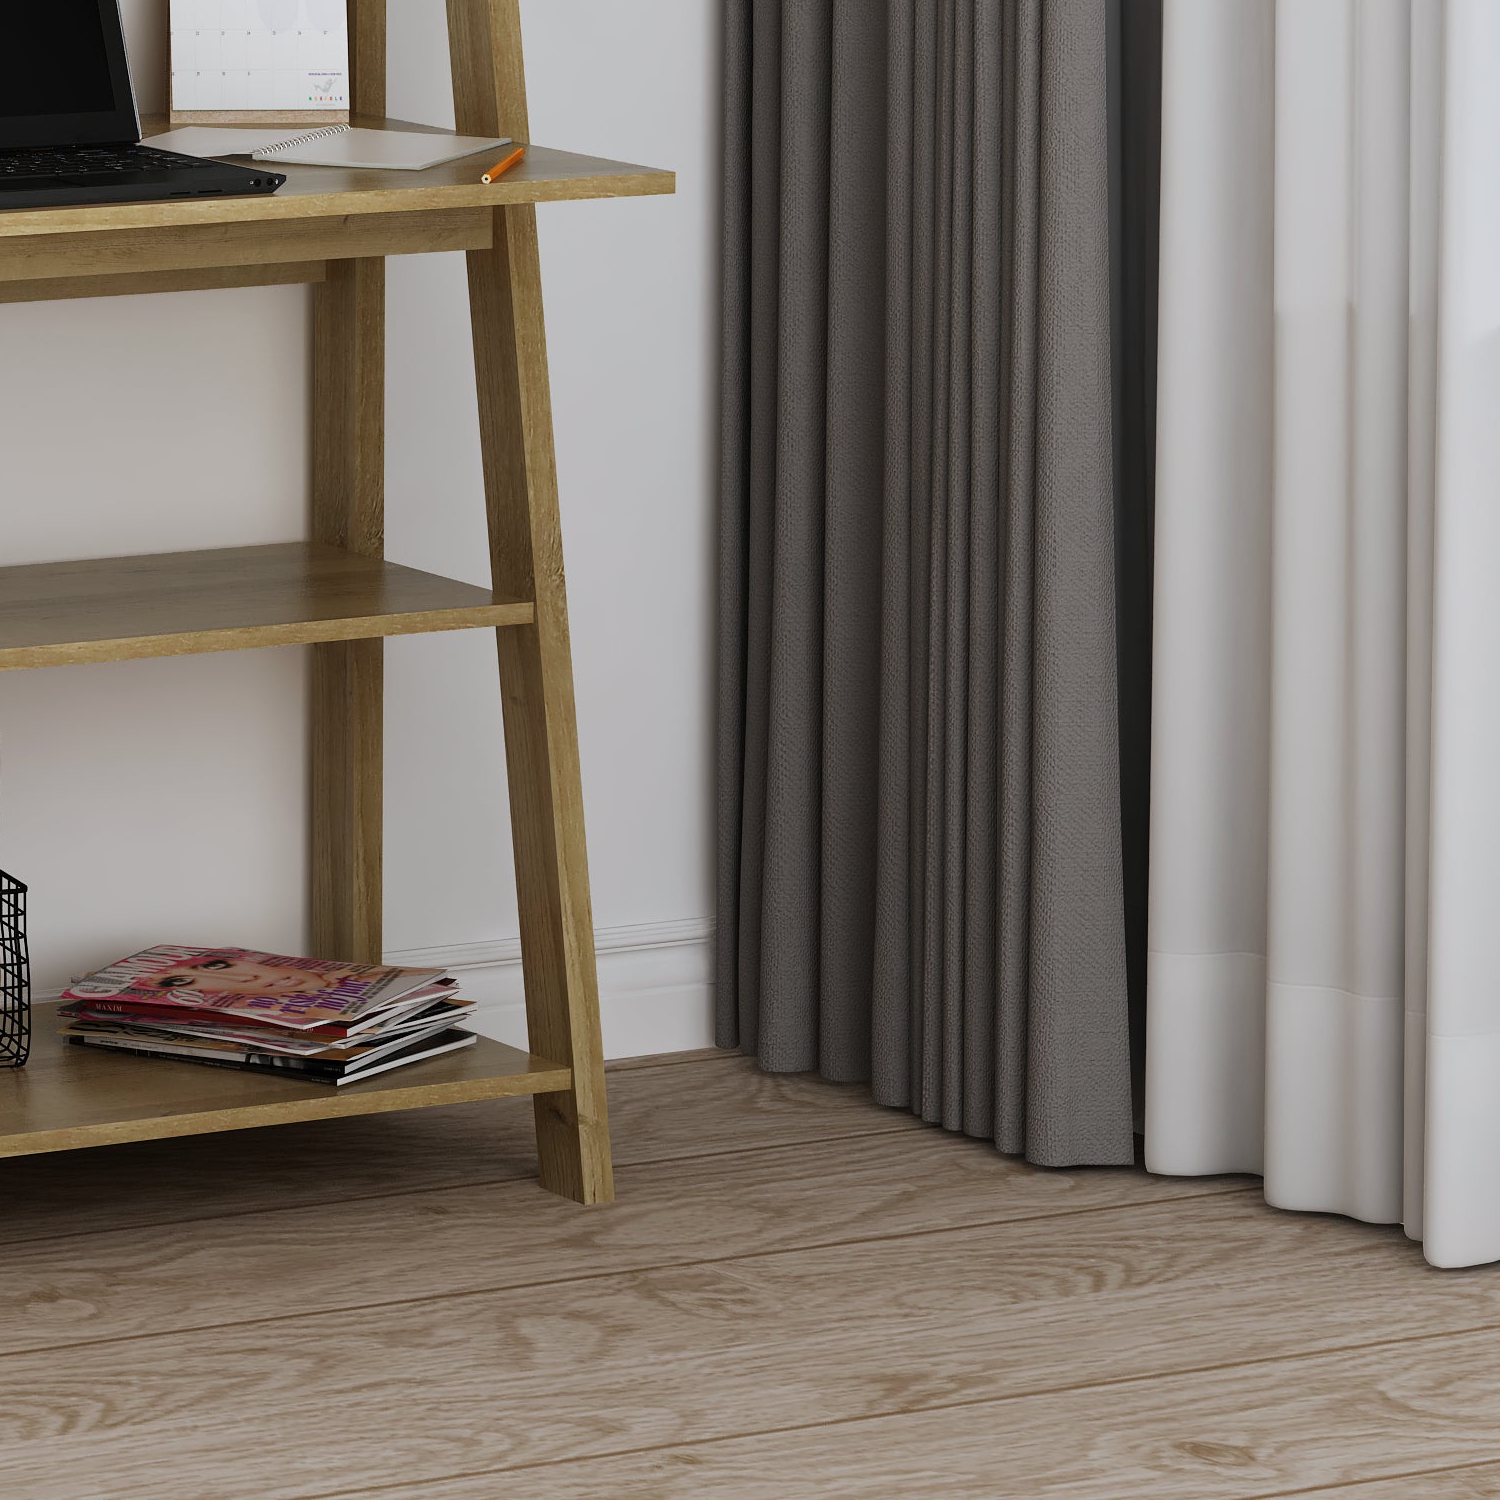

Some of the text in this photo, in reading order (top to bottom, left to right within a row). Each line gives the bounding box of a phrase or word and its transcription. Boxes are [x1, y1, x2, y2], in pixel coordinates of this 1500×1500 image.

[70, 945, 204, 998] GLAMOUR
[95, 1004, 122, 1012] MAXIM
[248, 996, 279, 1009] no
[314, 996, 349, 1011] no
